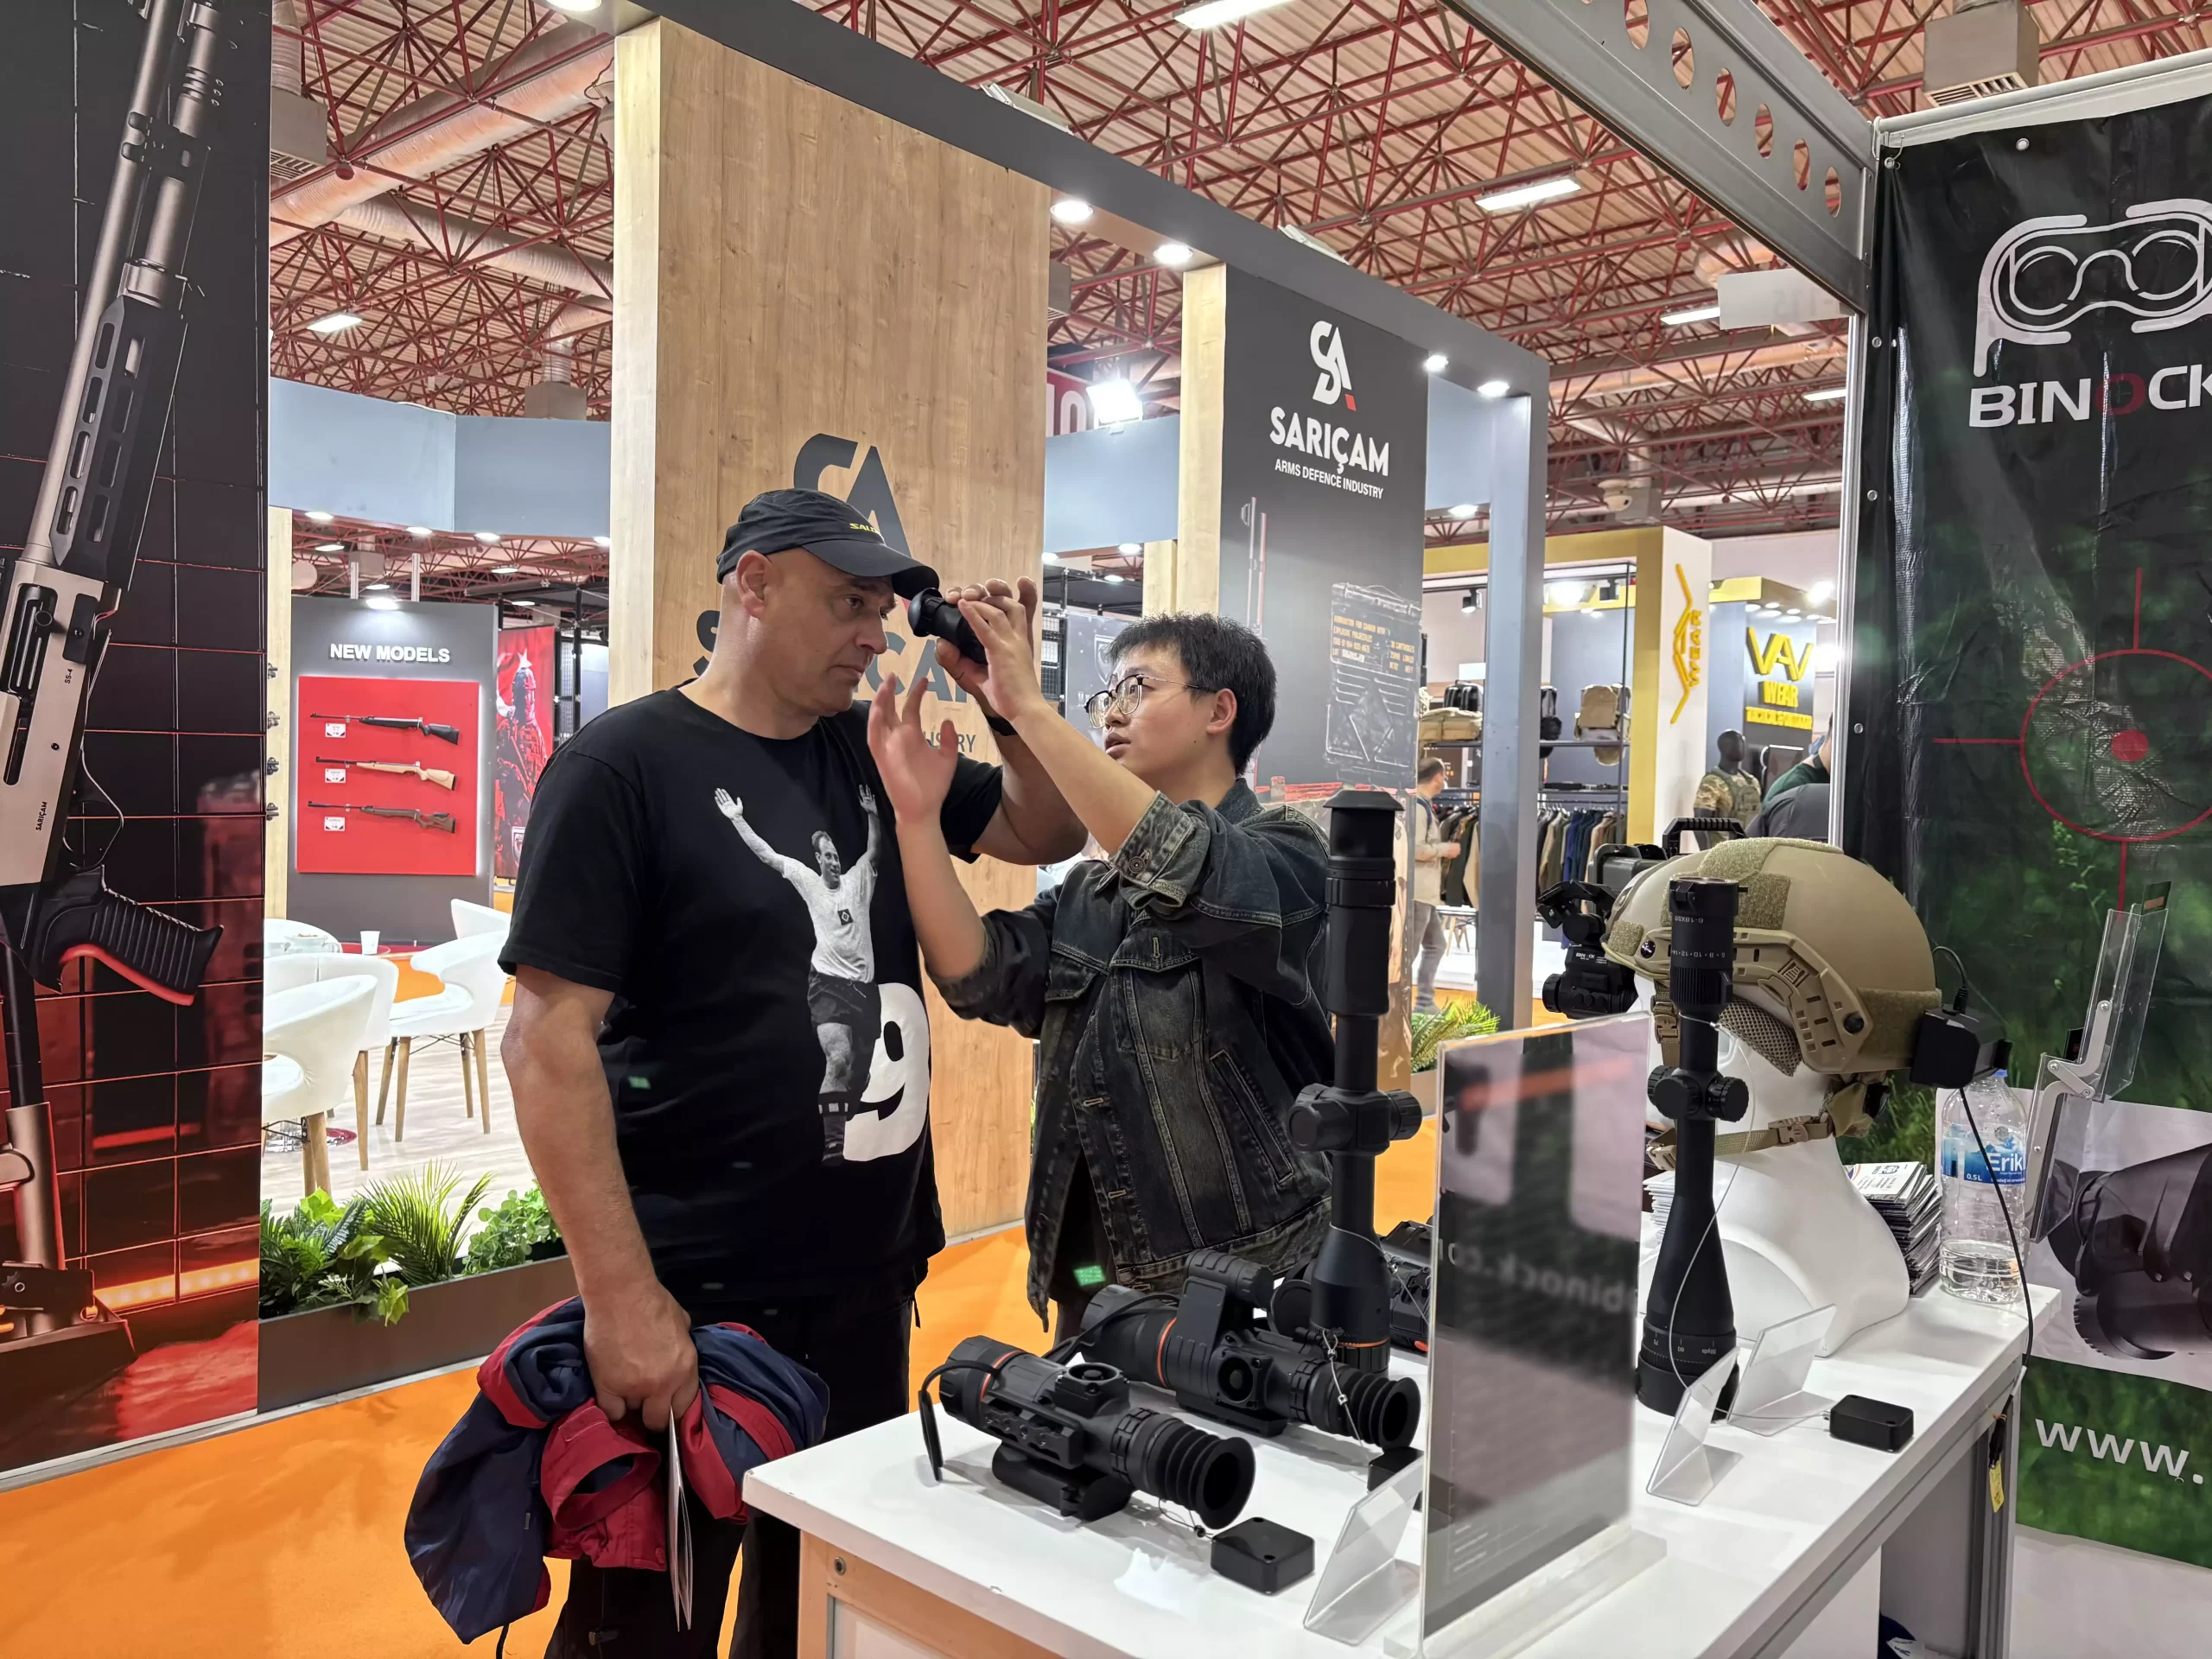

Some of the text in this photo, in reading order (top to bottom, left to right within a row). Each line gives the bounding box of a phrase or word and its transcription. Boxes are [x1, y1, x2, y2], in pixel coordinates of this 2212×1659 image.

[1269, 406, 1389, 477] SARIÇAM
[1274, 459, 1384, 499] ARMS DEFENCE INDUSTRY
[330, 644, 450, 663] NEW MODELS
[64, 669, 73, 684] SS-4
[1760, 680, 1798, 708] WEAR
[35, 801, 48, 831] SARIÇAM
[2035, 1418, 2204, 1484] www.
